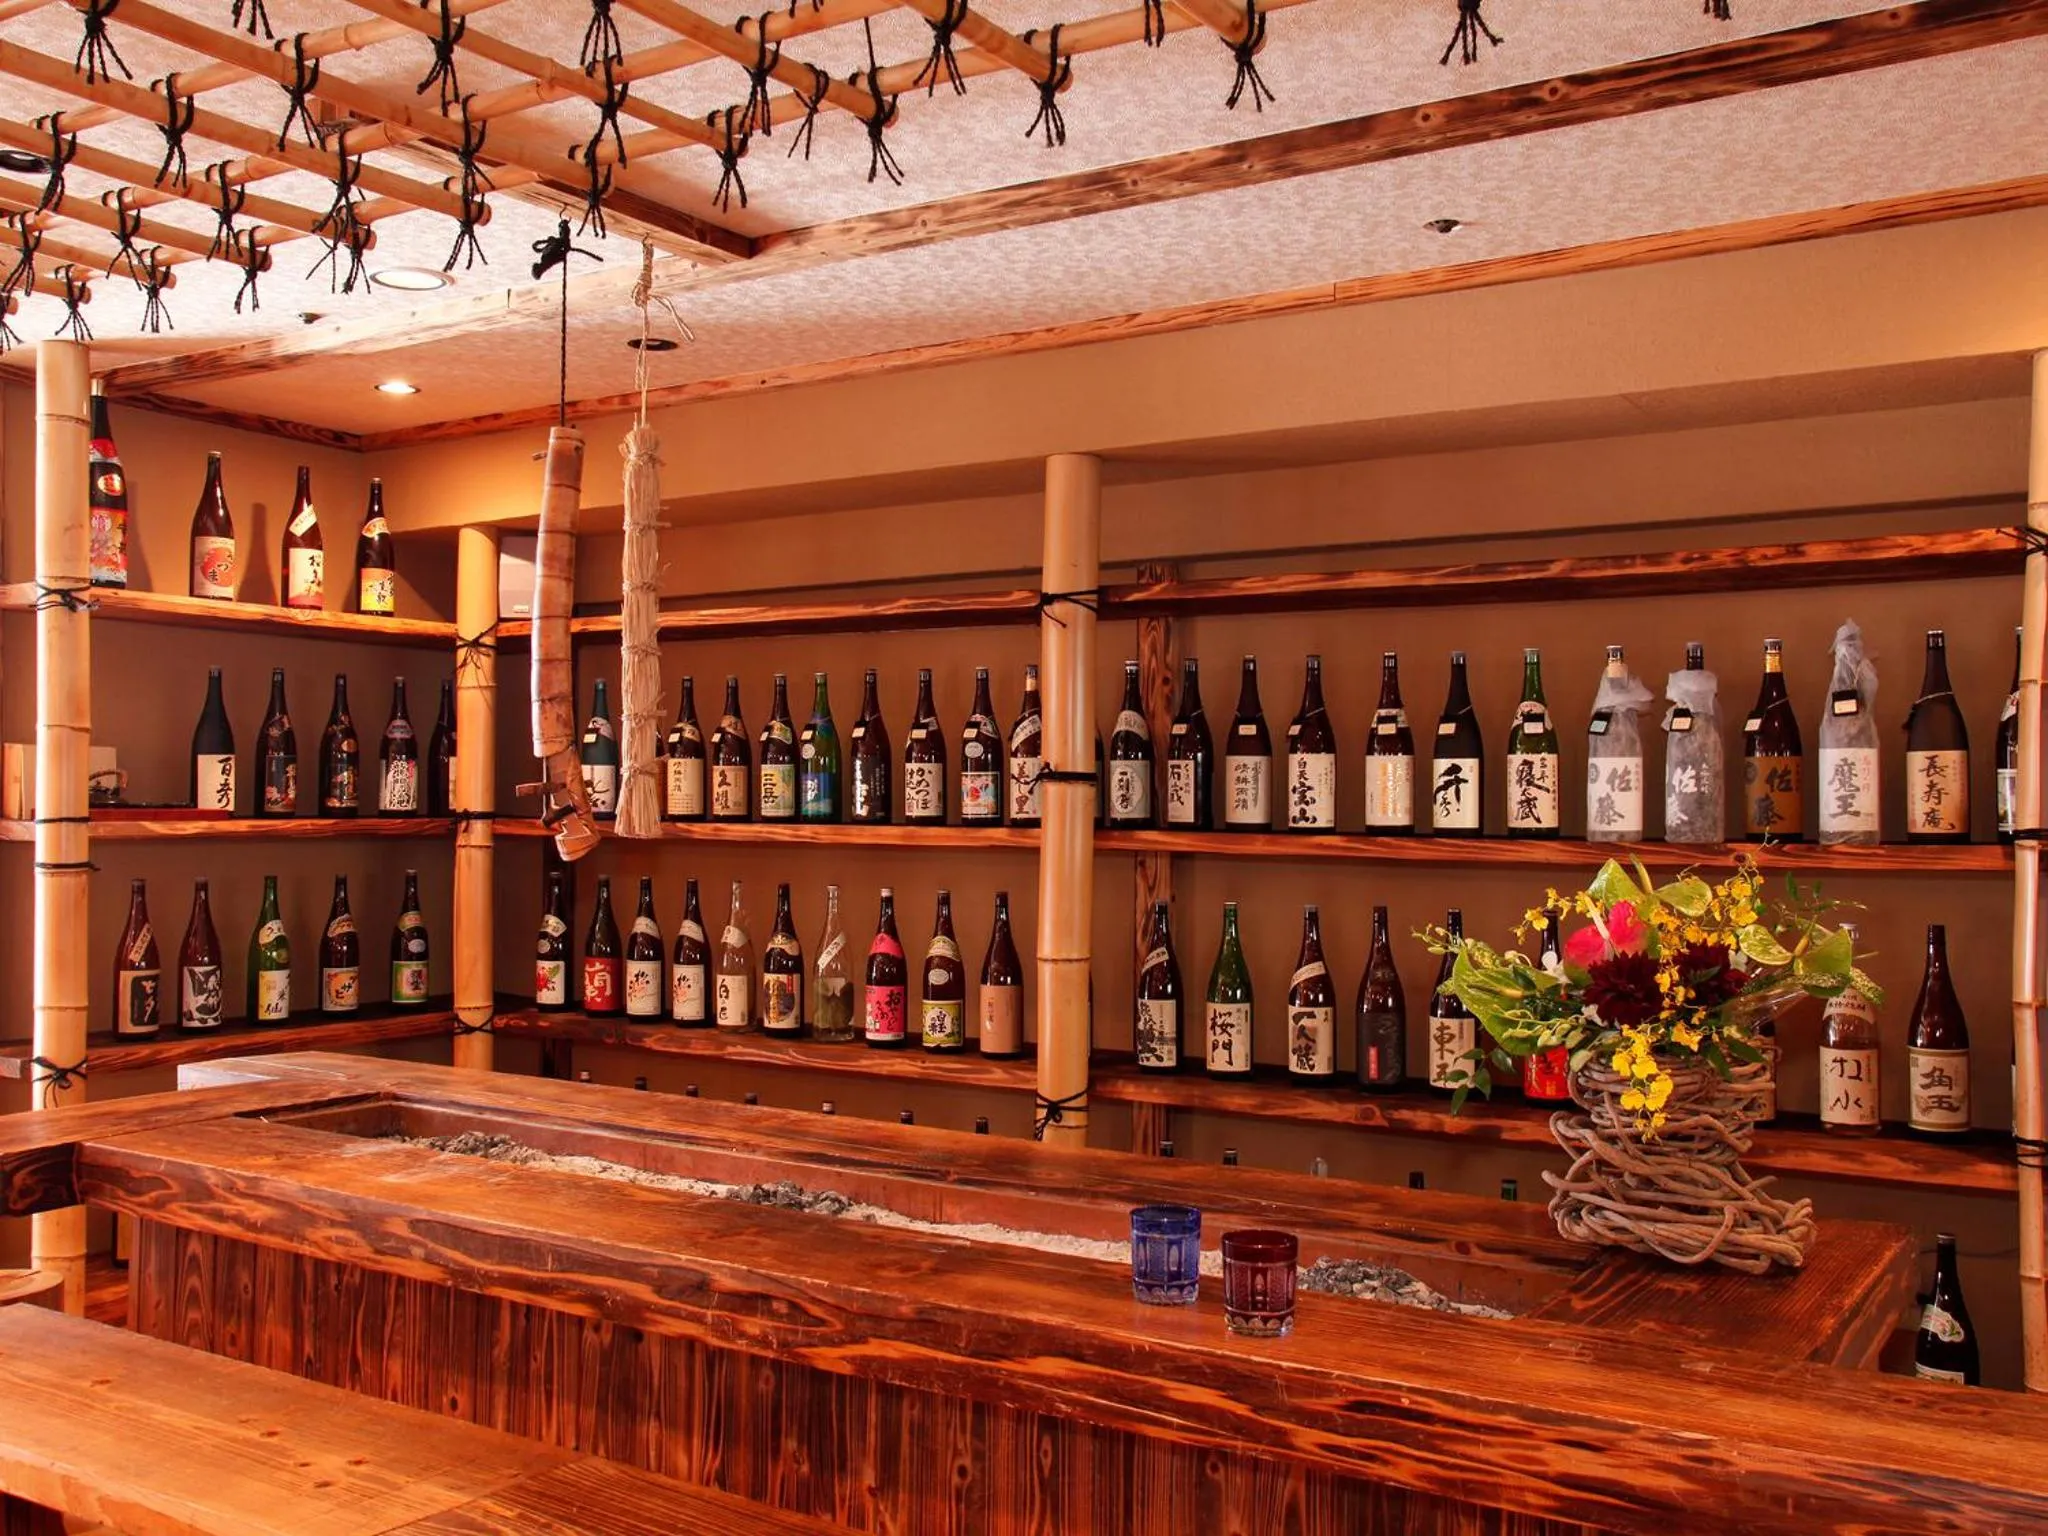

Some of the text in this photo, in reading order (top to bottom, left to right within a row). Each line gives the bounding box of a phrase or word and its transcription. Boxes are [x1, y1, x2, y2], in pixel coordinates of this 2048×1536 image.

[763, 773, 778, 804] 三岳
[1594, 764, 1632, 826] 佐藤
[1754, 766, 1794, 827] 佐藤
[1827, 757, 1862, 819] 魔王
